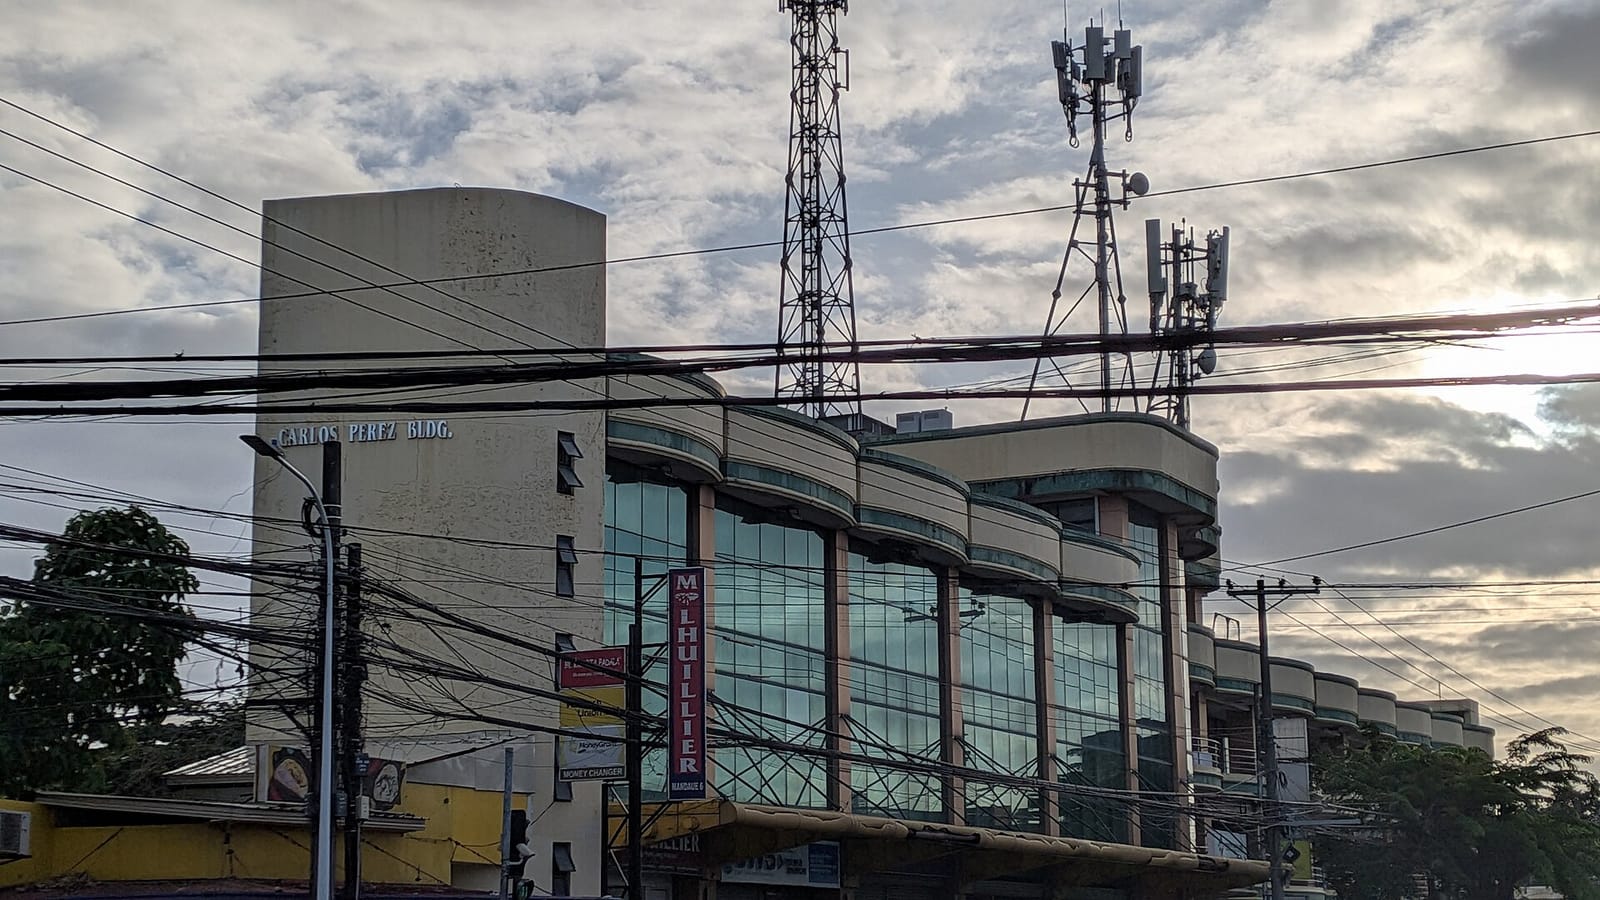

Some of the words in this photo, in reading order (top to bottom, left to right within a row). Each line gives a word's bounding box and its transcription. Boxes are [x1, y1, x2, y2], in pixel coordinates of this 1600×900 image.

[278, 425, 339, 447] CARLOS
[348, 421, 397, 443] PEREZ
[407, 420, 453, 439] BLDG.
[676, 574, 698, 590] M
[678, 609, 699, 773] LHUILLIER
[563, 770, 588, 778] MONEY
[588, 768, 623, 777] CHANGER
